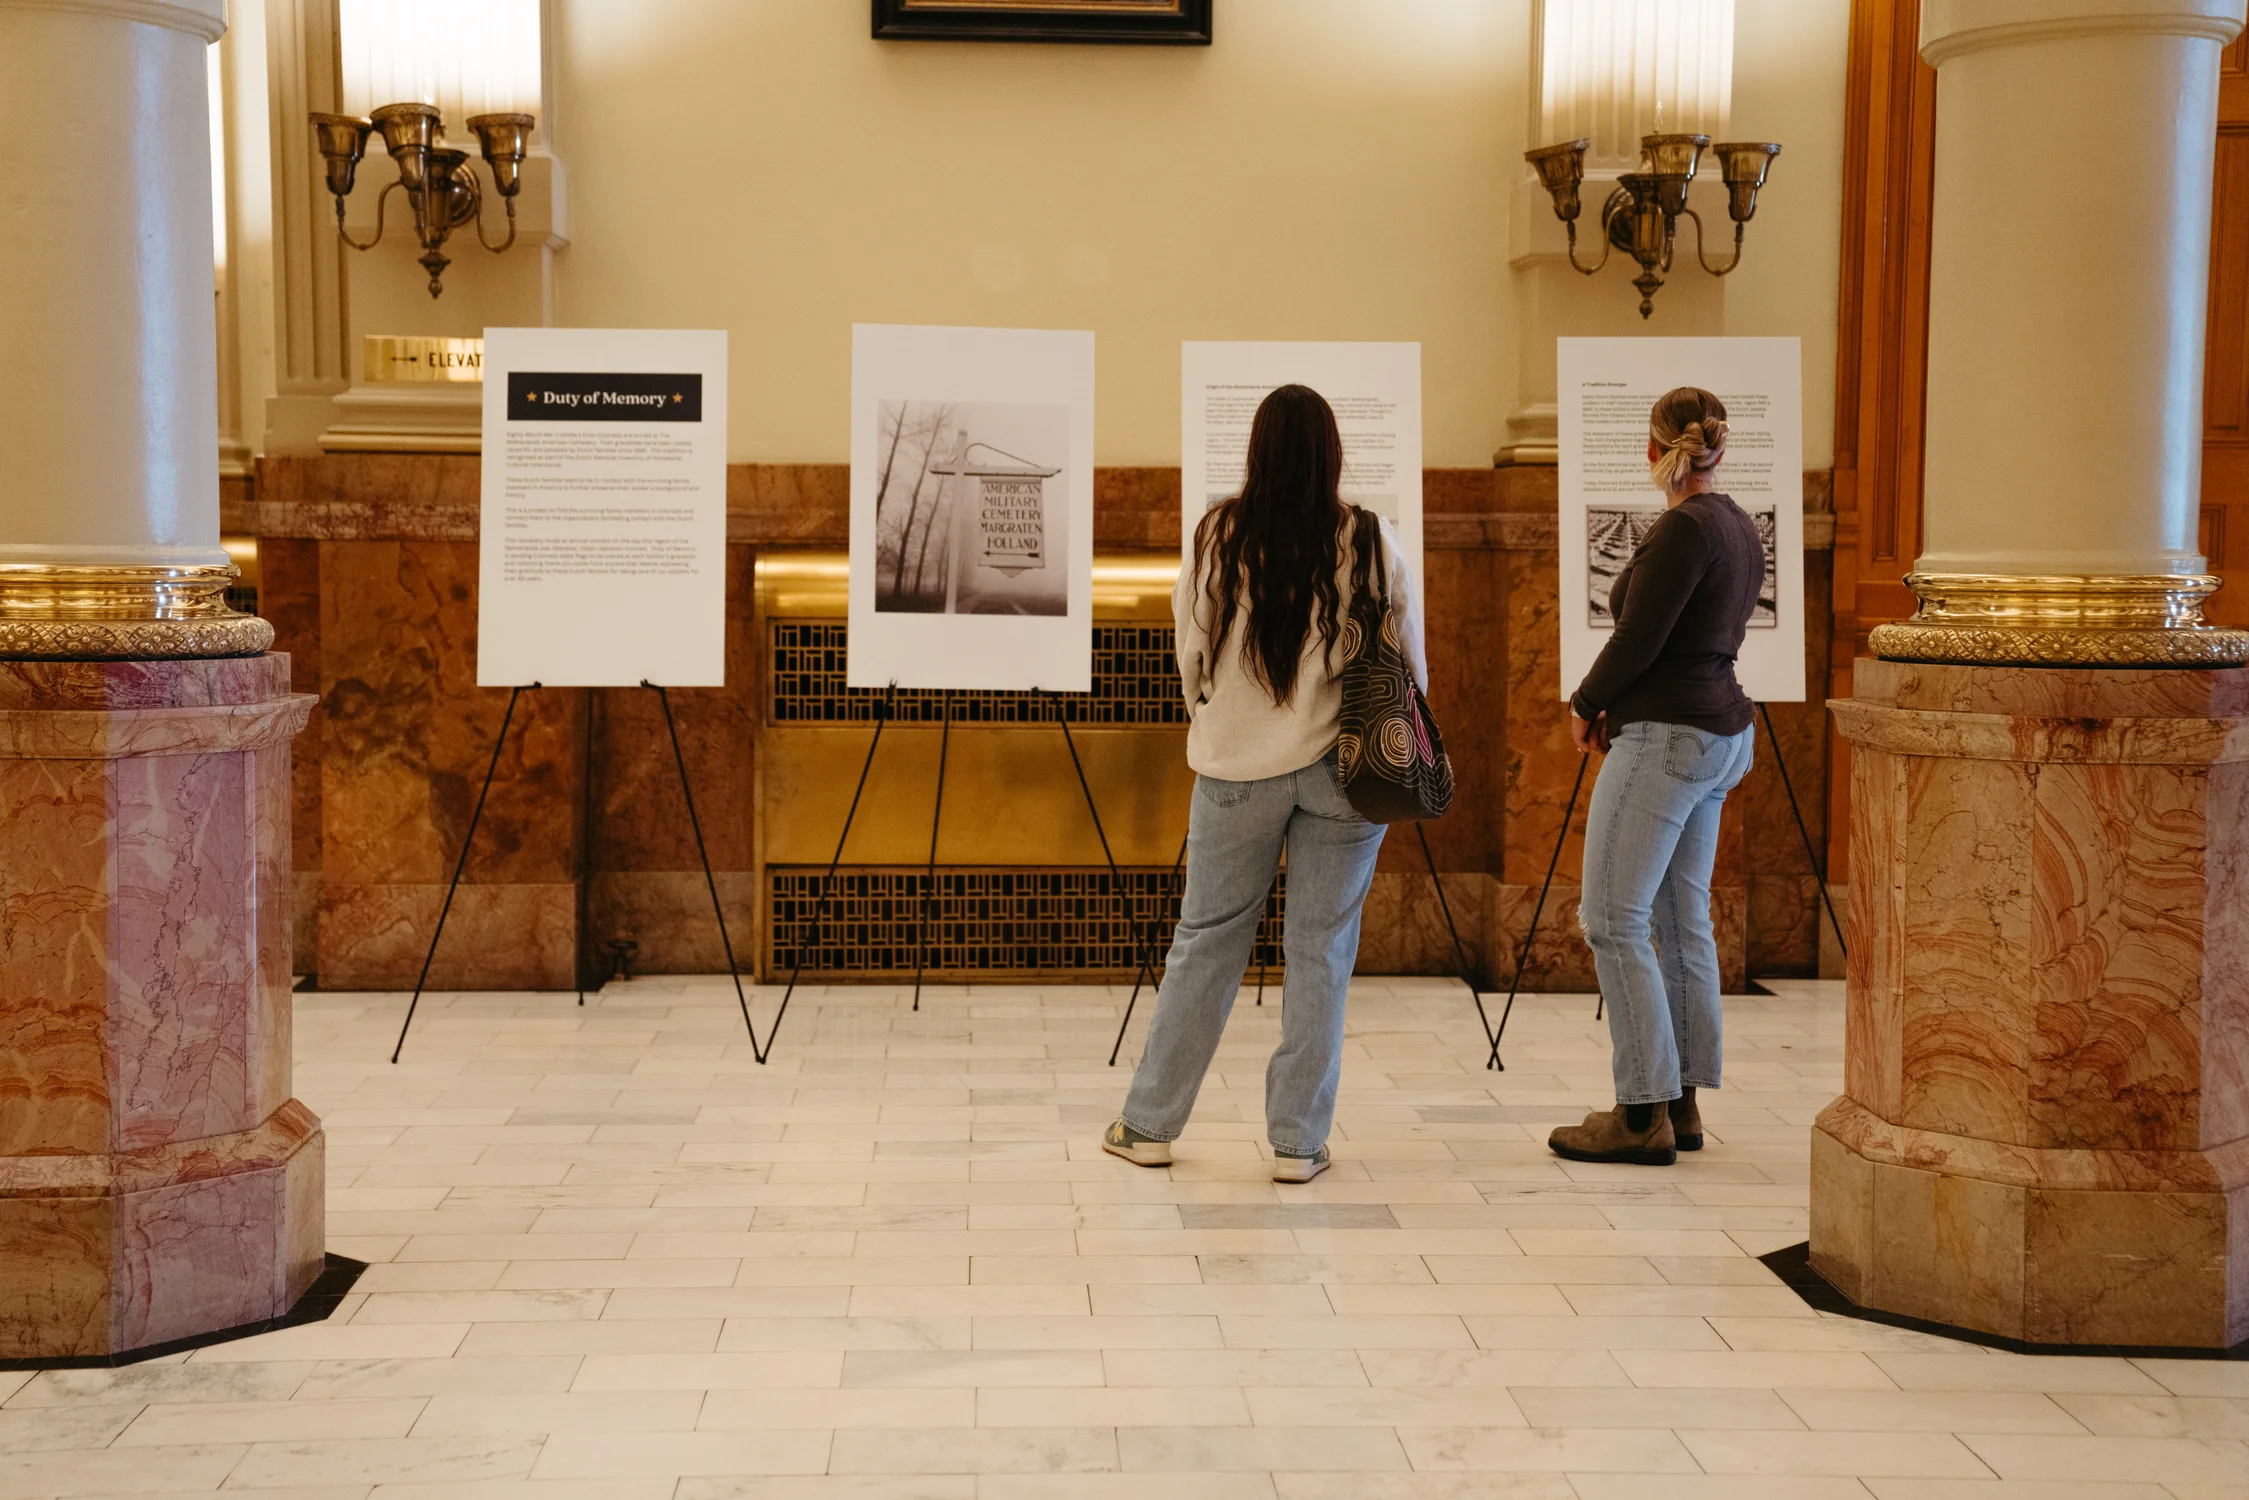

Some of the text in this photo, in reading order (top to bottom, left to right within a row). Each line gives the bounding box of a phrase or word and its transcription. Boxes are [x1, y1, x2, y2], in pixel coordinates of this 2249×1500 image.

[429, 352, 482, 368] ELEVAT
[543, 391, 666, 408] Duty of Memory
[983, 484, 1041, 494] AMERICAN
[985, 496, 1038, 507] MILITARY
[982, 509, 1041, 520] CEMETERY
[980, 522, 1042, 534] MARGRATEN
[987, 537, 1038, 549] HOLLAND
